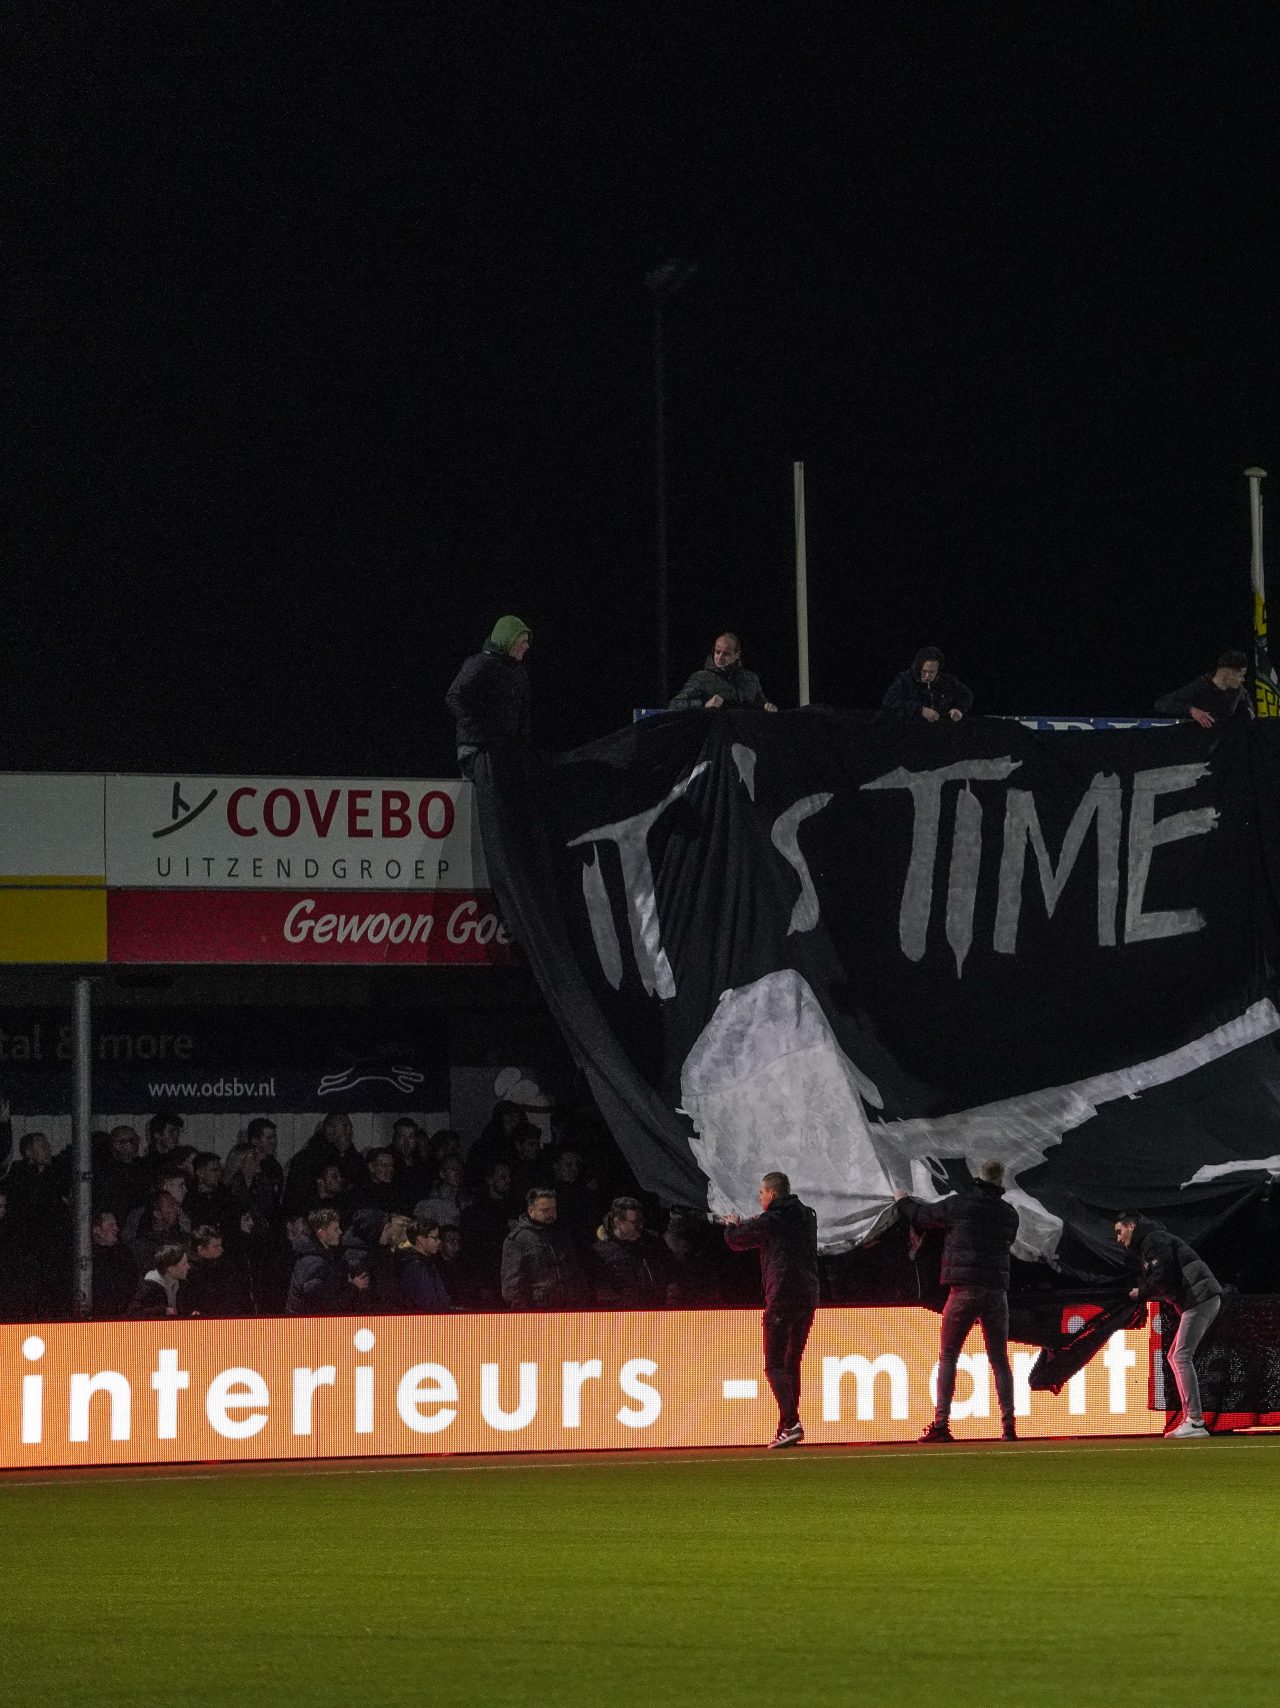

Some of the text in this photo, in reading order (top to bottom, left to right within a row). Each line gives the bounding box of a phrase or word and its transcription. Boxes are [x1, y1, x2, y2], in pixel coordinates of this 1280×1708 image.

[227, 787, 455, 839] COVEBO
[157, 857, 450, 880] UITZENDGROEP
[860, 754, 1221, 980] TIME
[283, 898, 434, 945] Gewoon
[149, 1077, 276, 1098] www.odsbv.nl
[20, 1327, 663, 1444] interieurs
